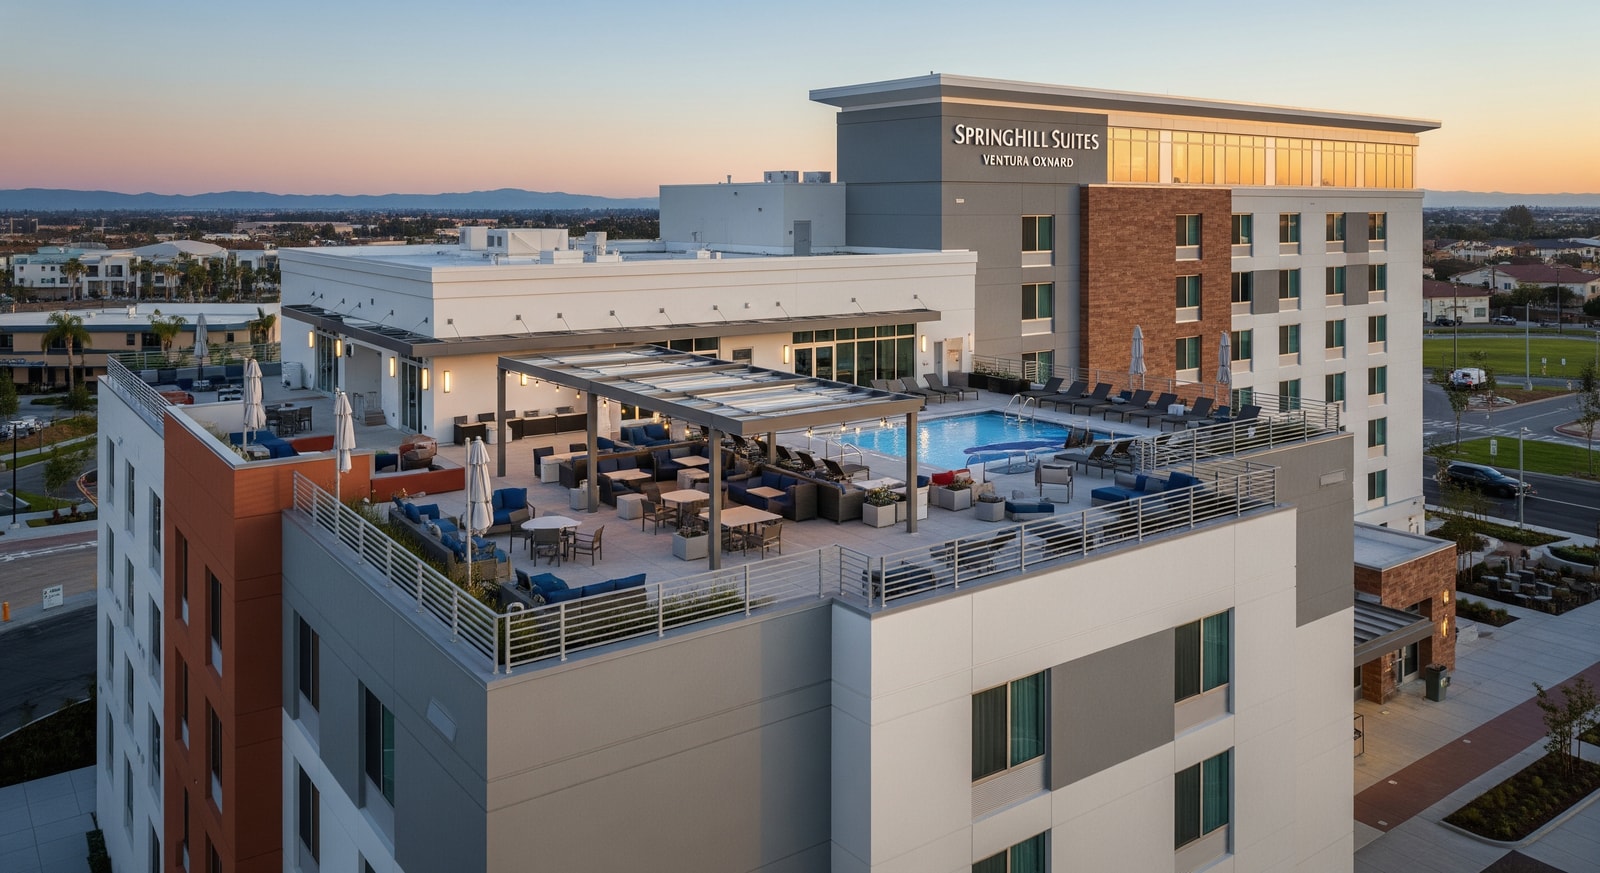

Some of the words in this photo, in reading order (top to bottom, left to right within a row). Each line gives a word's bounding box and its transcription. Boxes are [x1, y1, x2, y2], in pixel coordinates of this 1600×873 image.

[954, 123, 1048, 148] SPRINGHILL
[1051, 129, 1100, 150] SUITES
[983, 154, 1029, 167] VENTURA
[1032, 155, 1074, 168] OXNARD
